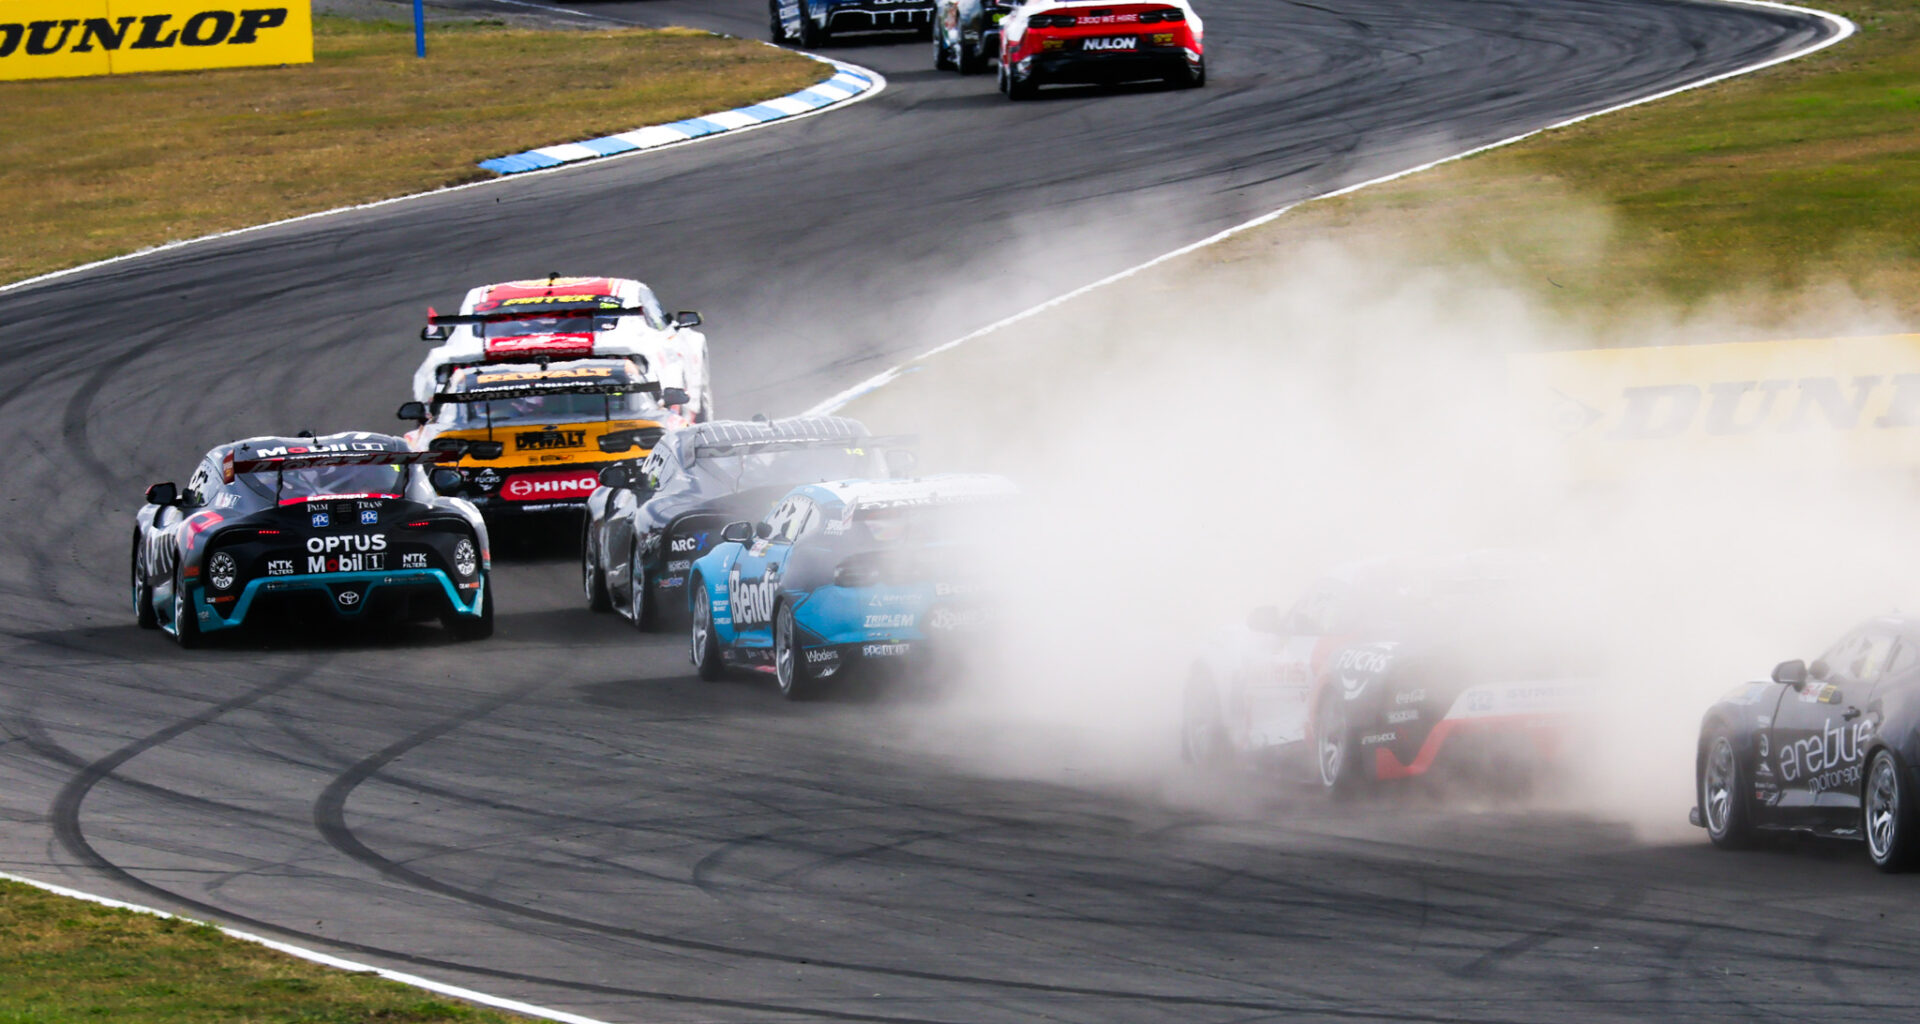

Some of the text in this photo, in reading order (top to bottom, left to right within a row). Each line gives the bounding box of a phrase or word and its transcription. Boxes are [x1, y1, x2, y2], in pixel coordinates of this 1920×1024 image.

[1077, 14, 1138, 24] 1300 WE HIRE
[1082, 37, 1137, 51] NULON
[1602, 373, 1920, 441] DUNL
[514, 430, 586, 450] DEWALT
[534, 477, 598, 493] HINO
[306, 503, 329, 513] PALM
[313, 514, 329, 527] PPG
[361, 511, 378, 524] PPG
[306, 533, 387, 553] OPTUS
[268, 560, 293, 570] NTK
[307, 553, 363, 573] Mobil
[402, 553, 427, 563] NTK
[402, 561, 428, 569] FILTERS
[268, 568, 294, 576] FILTERS
[1336, 649, 1389, 673] FUCHS
[1780, 717, 1875, 781] erebus
[1808, 764, 1862, 794] motorspo
